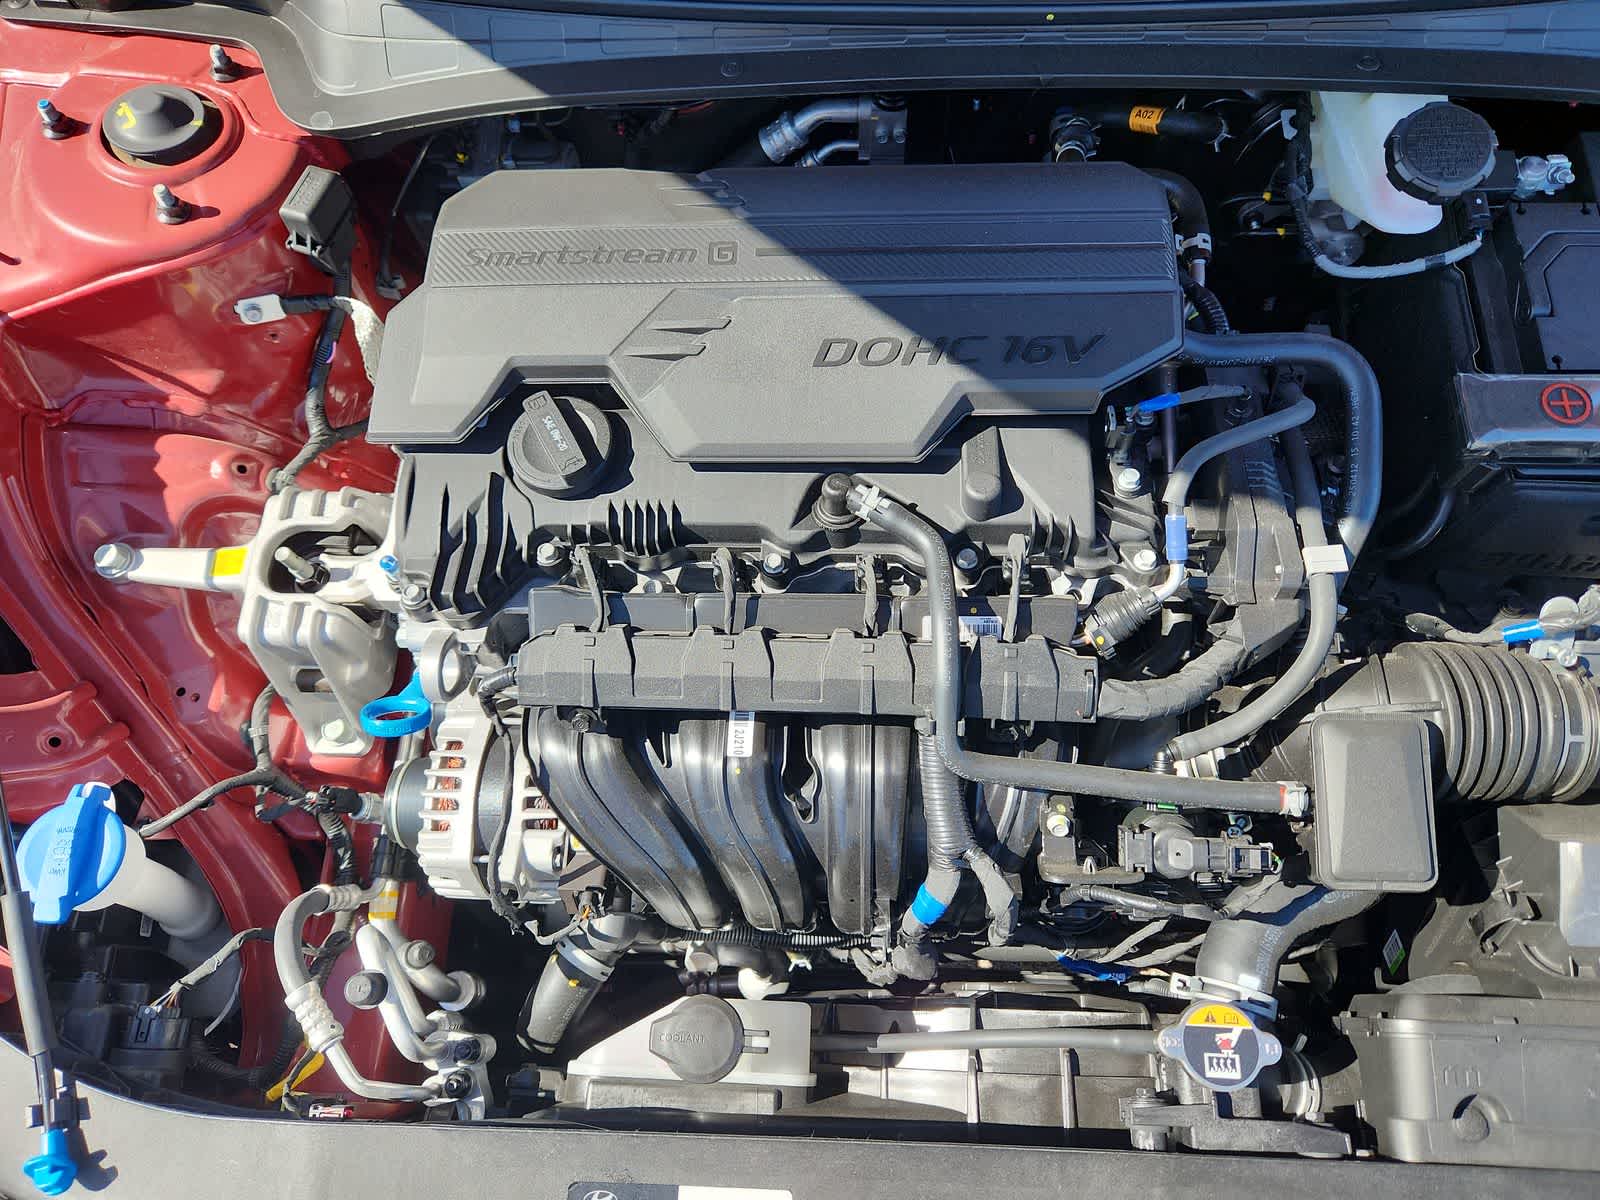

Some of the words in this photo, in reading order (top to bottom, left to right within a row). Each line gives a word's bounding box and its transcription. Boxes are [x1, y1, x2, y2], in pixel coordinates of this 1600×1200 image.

[1135, 109, 1153, 119] A02
[465, 245, 699, 267] Smartstream
[708, 241, 738, 265] G
[812, 335, 986, 367] DOHC
[1003, 333, 1108, 368] 16V
[542, 415, 558, 431] SAE
[658, 1032, 705, 1044] COOLANT
